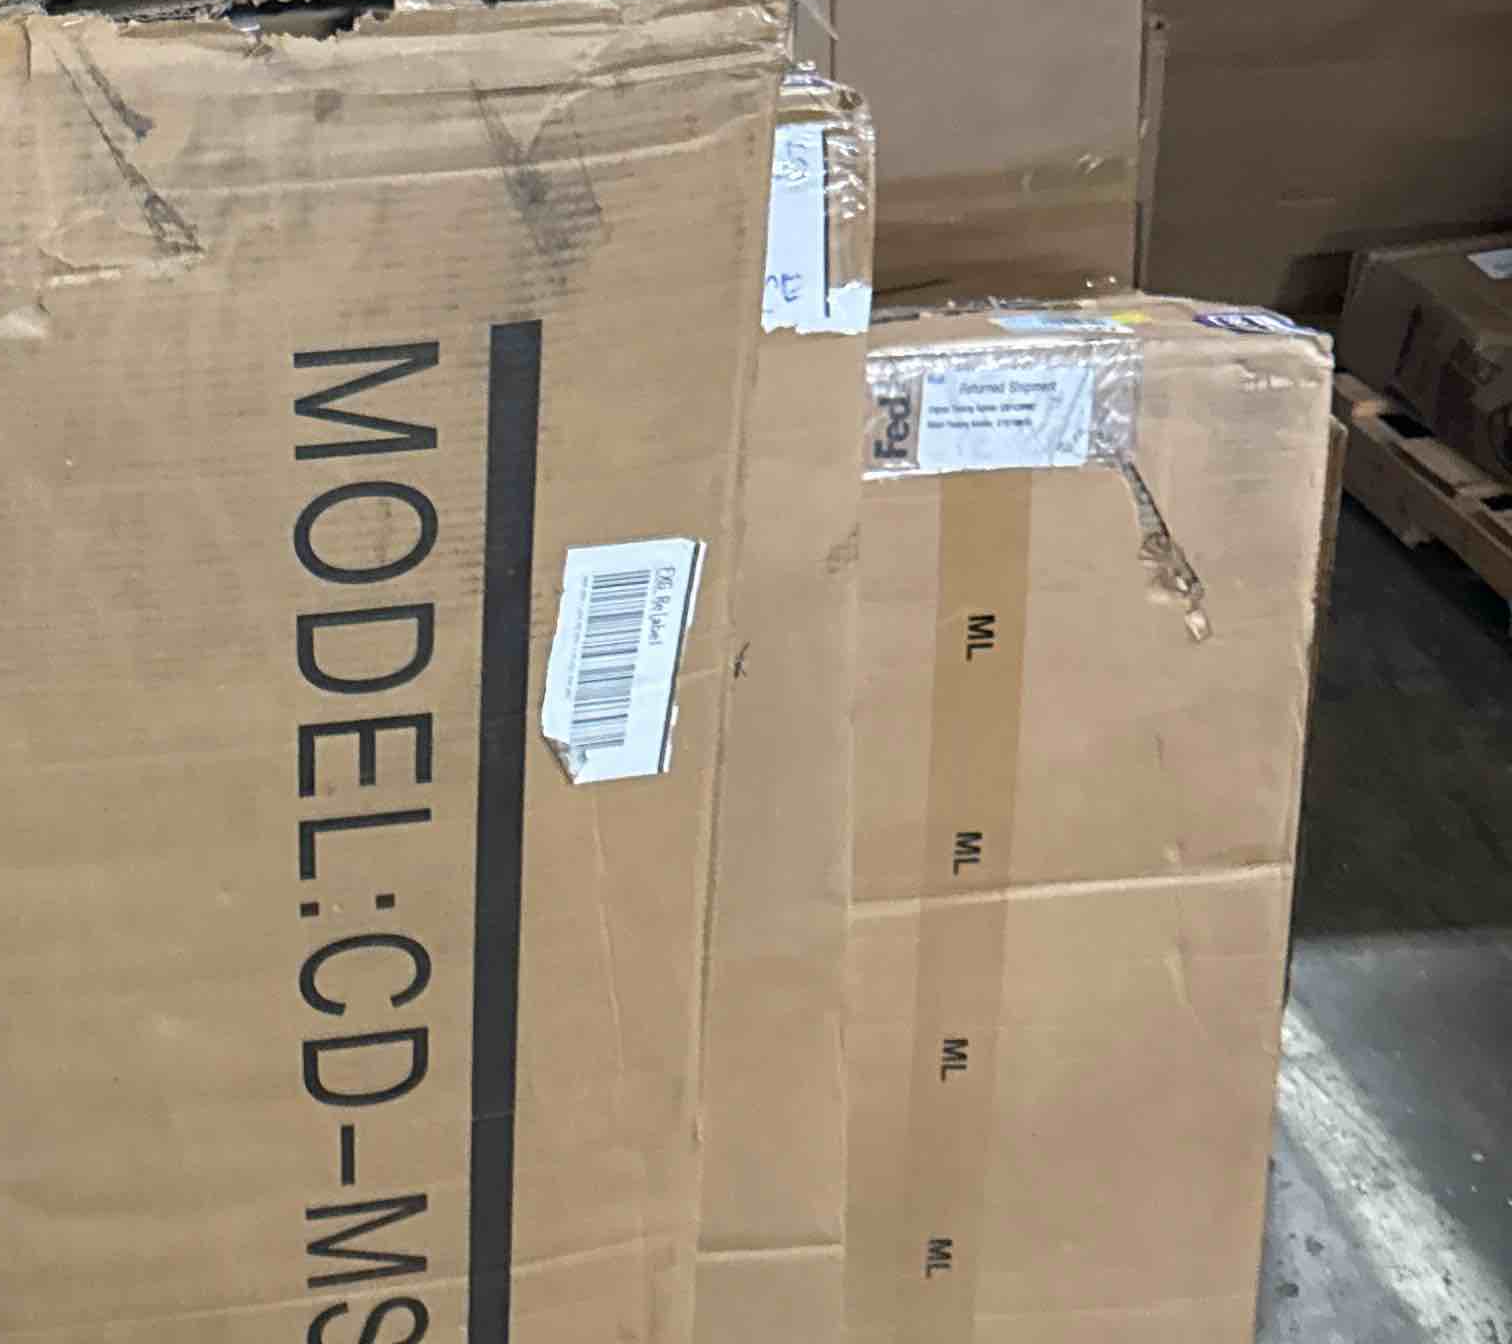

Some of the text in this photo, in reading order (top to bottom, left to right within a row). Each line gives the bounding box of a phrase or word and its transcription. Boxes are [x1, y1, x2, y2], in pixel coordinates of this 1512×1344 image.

[966, 614, 997, 662] ML
[953, 831, 984, 877] ML
[940, 1038, 970, 1083] ML
[926, 1238, 954, 1279] ML
